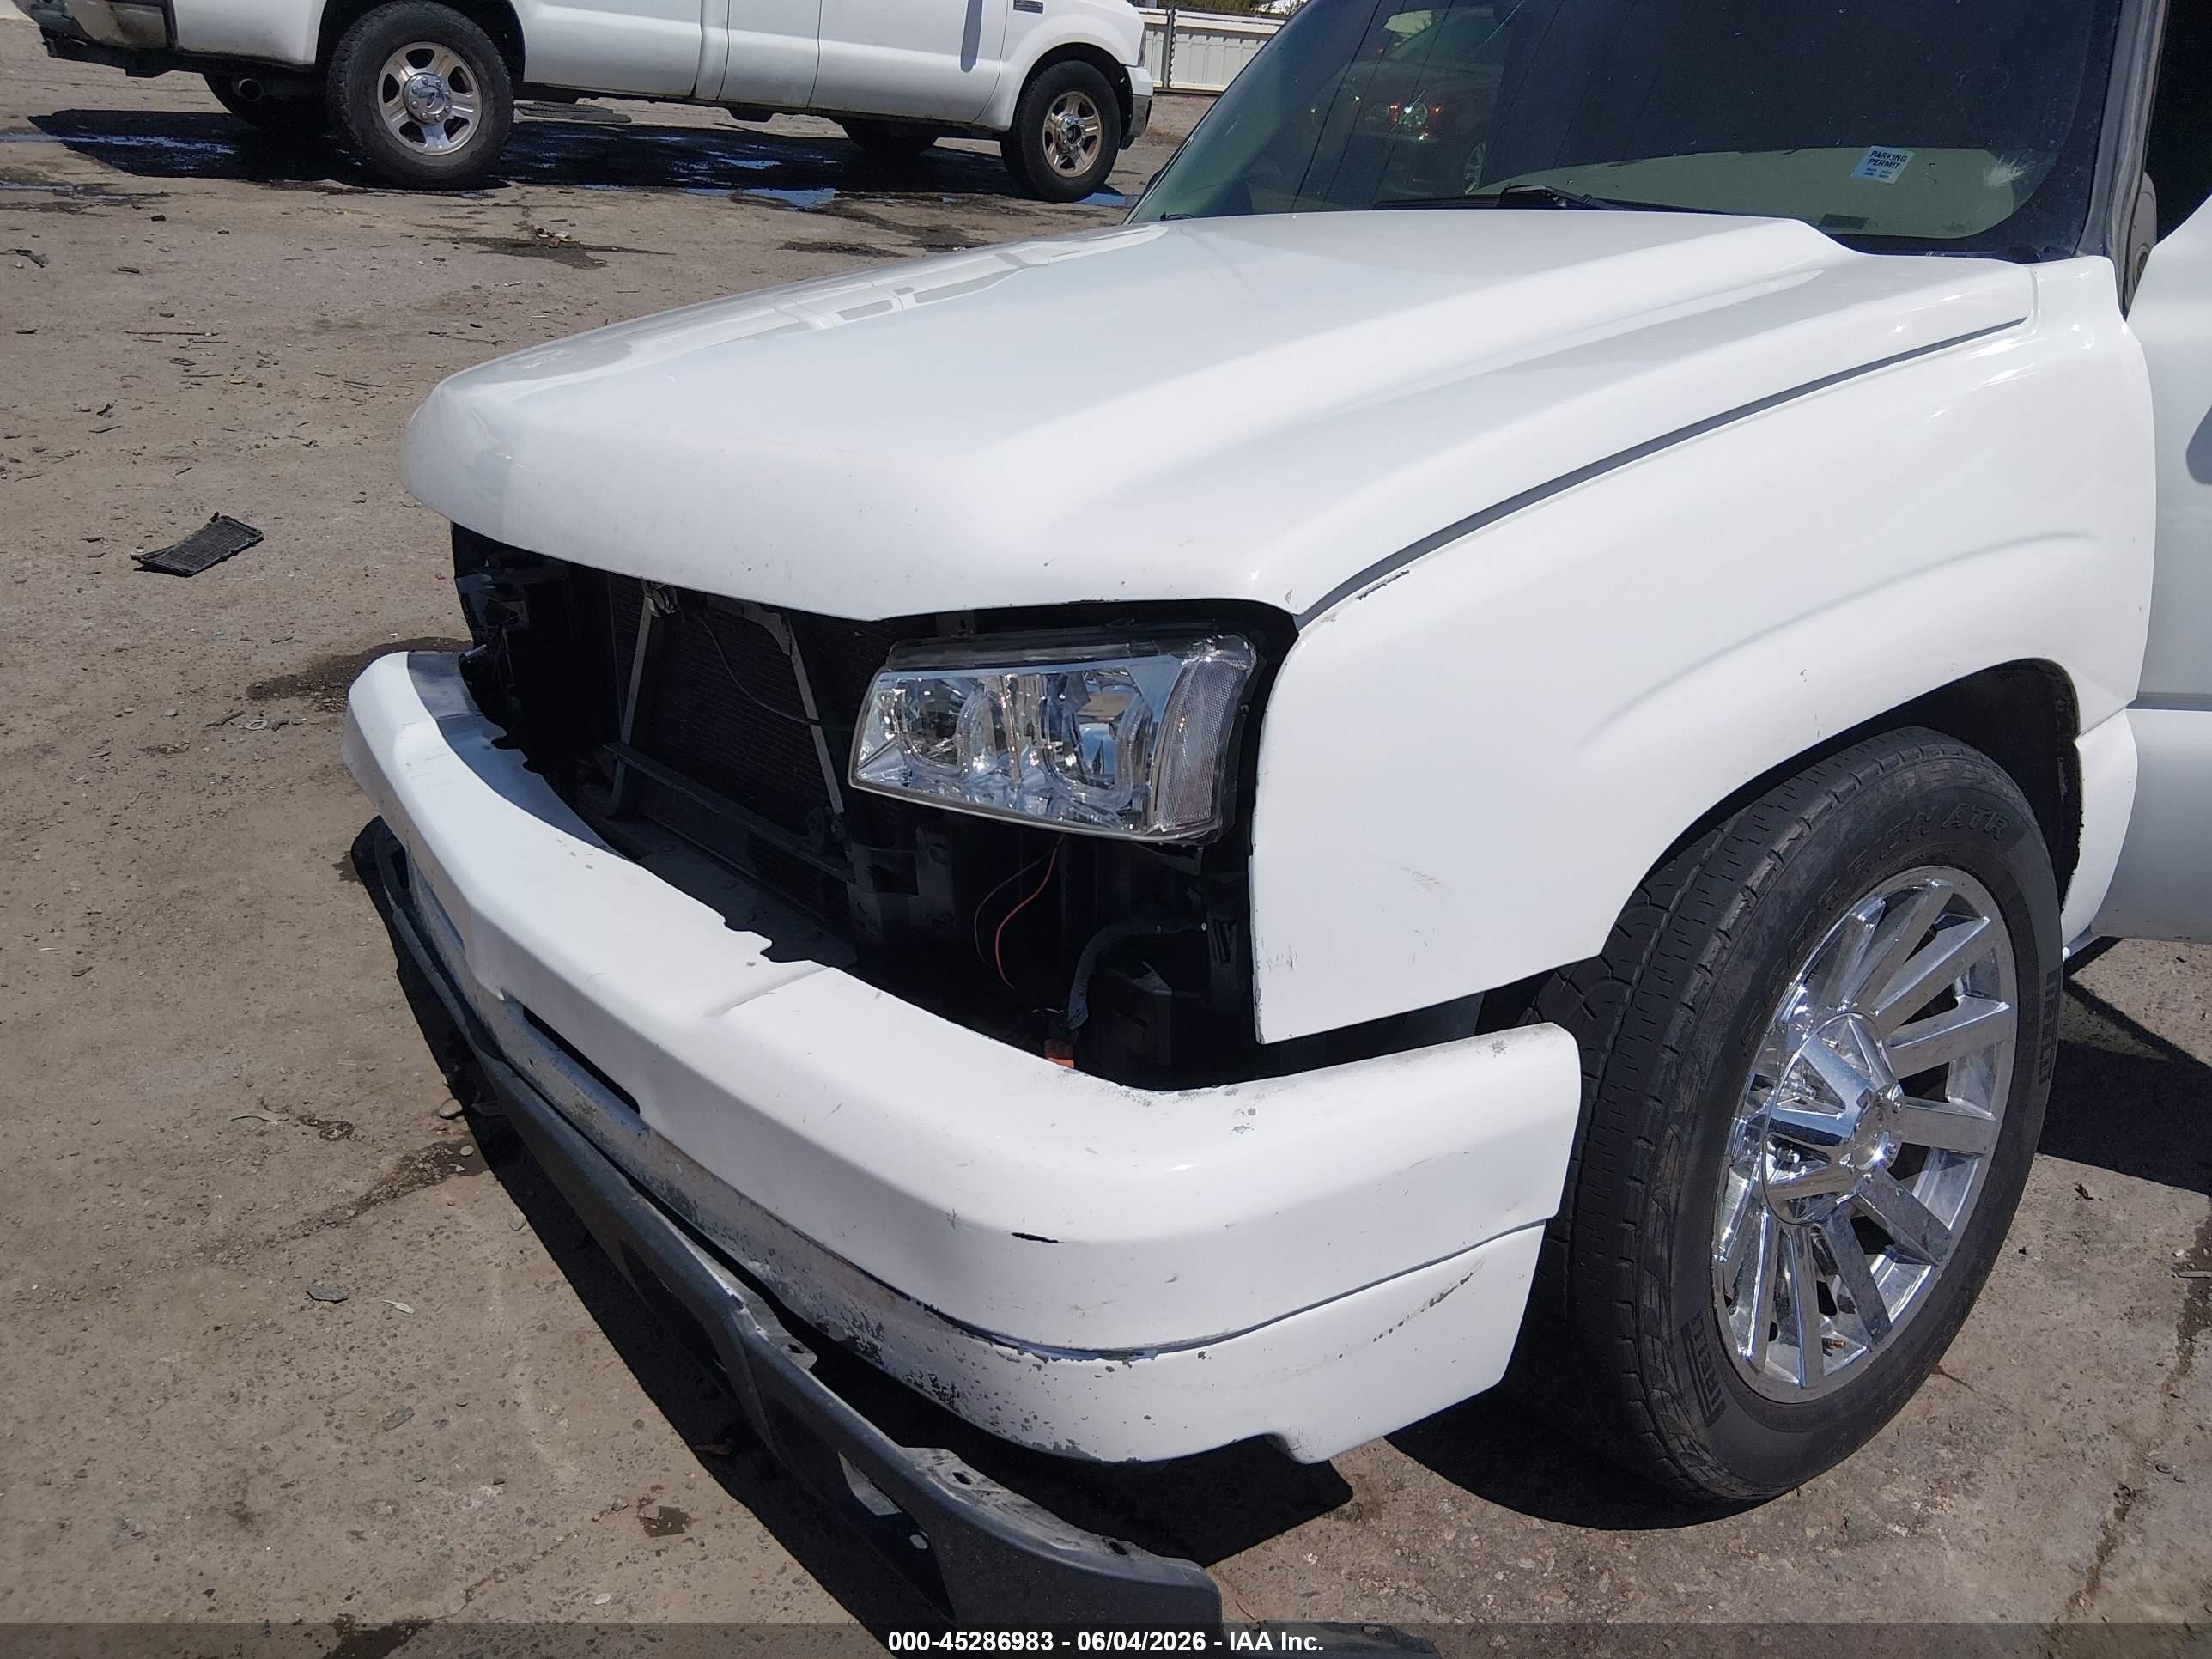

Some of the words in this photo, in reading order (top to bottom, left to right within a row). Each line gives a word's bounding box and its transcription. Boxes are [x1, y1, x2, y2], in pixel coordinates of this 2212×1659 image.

[1869, 150, 1907, 162] PARKING
[1868, 158, 1901, 169] PERMIT
[1941, 803, 2010, 841] ATR
